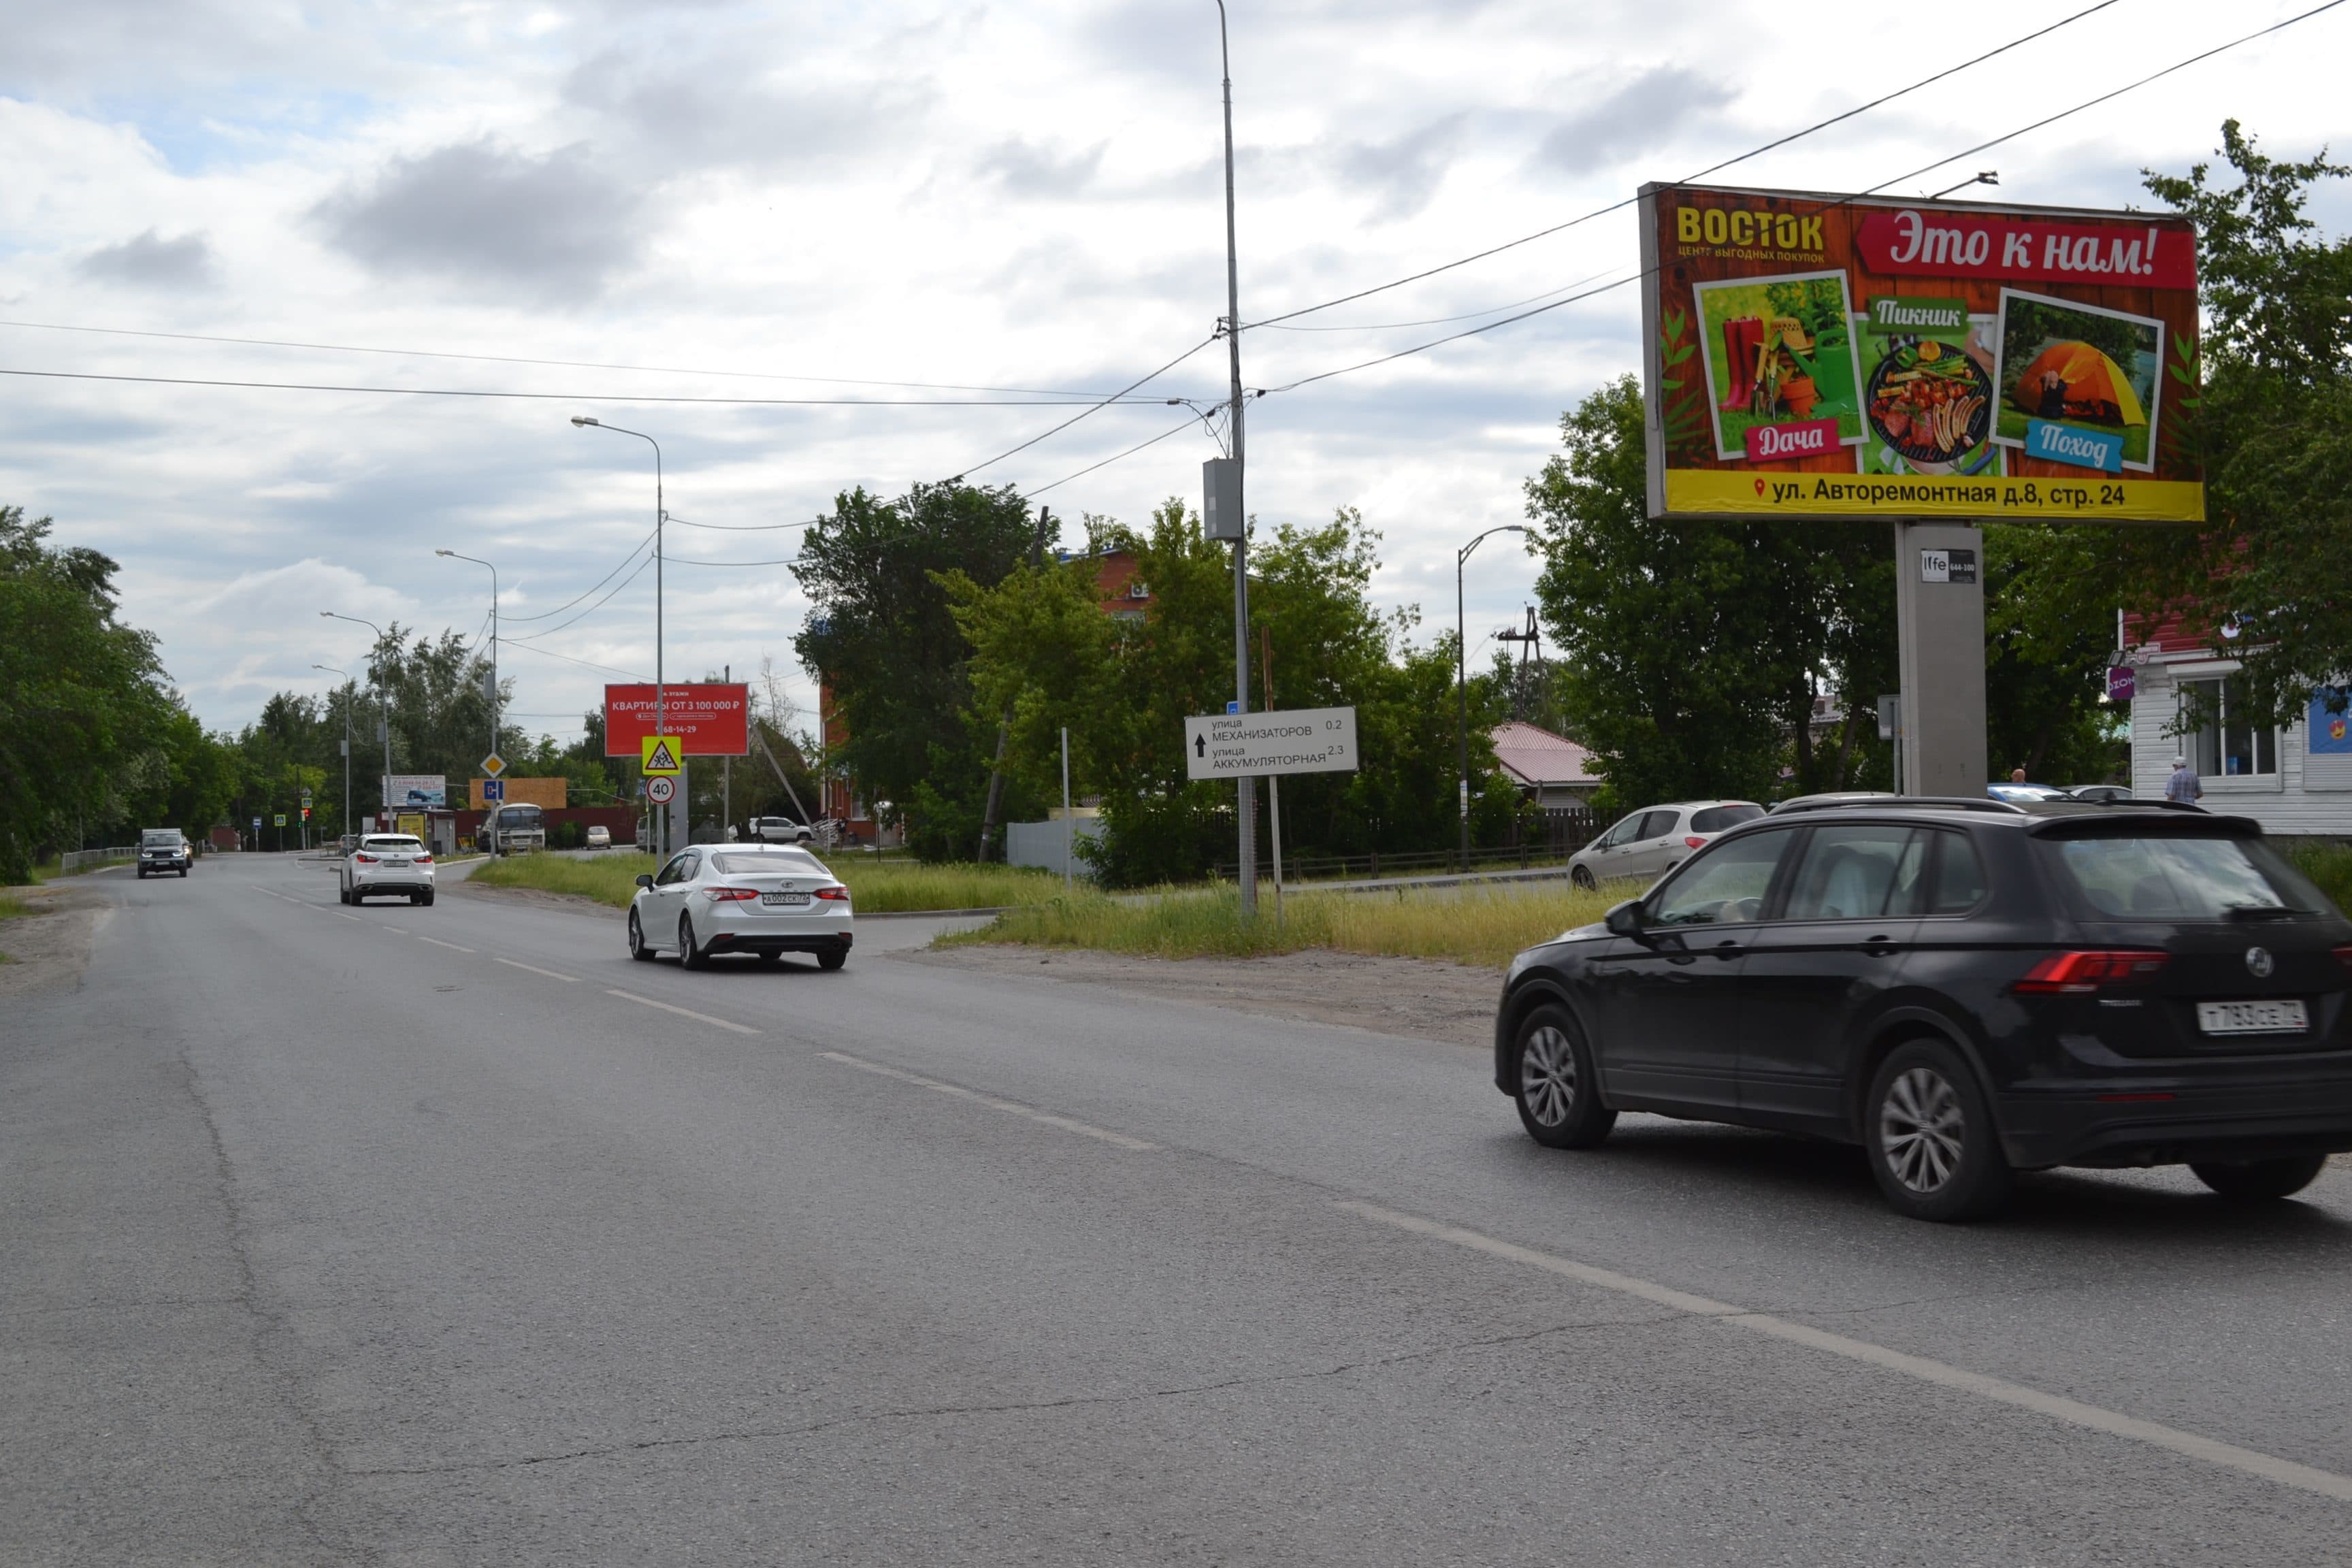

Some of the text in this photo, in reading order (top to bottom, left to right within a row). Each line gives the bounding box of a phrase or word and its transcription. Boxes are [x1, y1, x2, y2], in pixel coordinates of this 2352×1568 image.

[1677, 207, 1823, 250] ВОСТОК
[1715, 247, 1774, 261] ВЫГОДНЫХ
[1776, 252, 1825, 263] ПОКУПОК
[1890, 210, 2158, 275] Это к нам!
[1876, 299, 1961, 327] Пикник
[1759, 427, 1824, 456] Дача
[2040, 424, 2108, 468] Поход
[1772, 478, 2125, 509] ул. Авторемонтная д.8, стр. 24
[672, 701, 686, 710] ОТ
[688, 701, 694, 710] 3
[696, 701, 711, 710] 100
[713, 701, 731, 710] 000
[1211, 720, 1242, 731] улица
[1212, 720, 1342, 742] МЕХАНИЗАТОРОВ 0.2
[1212, 747, 1245, 759] улица
[1213, 745, 1344, 770] АККУМУЛЯТОРНАЯ 2.3
[653, 783, 669, 795] 40
